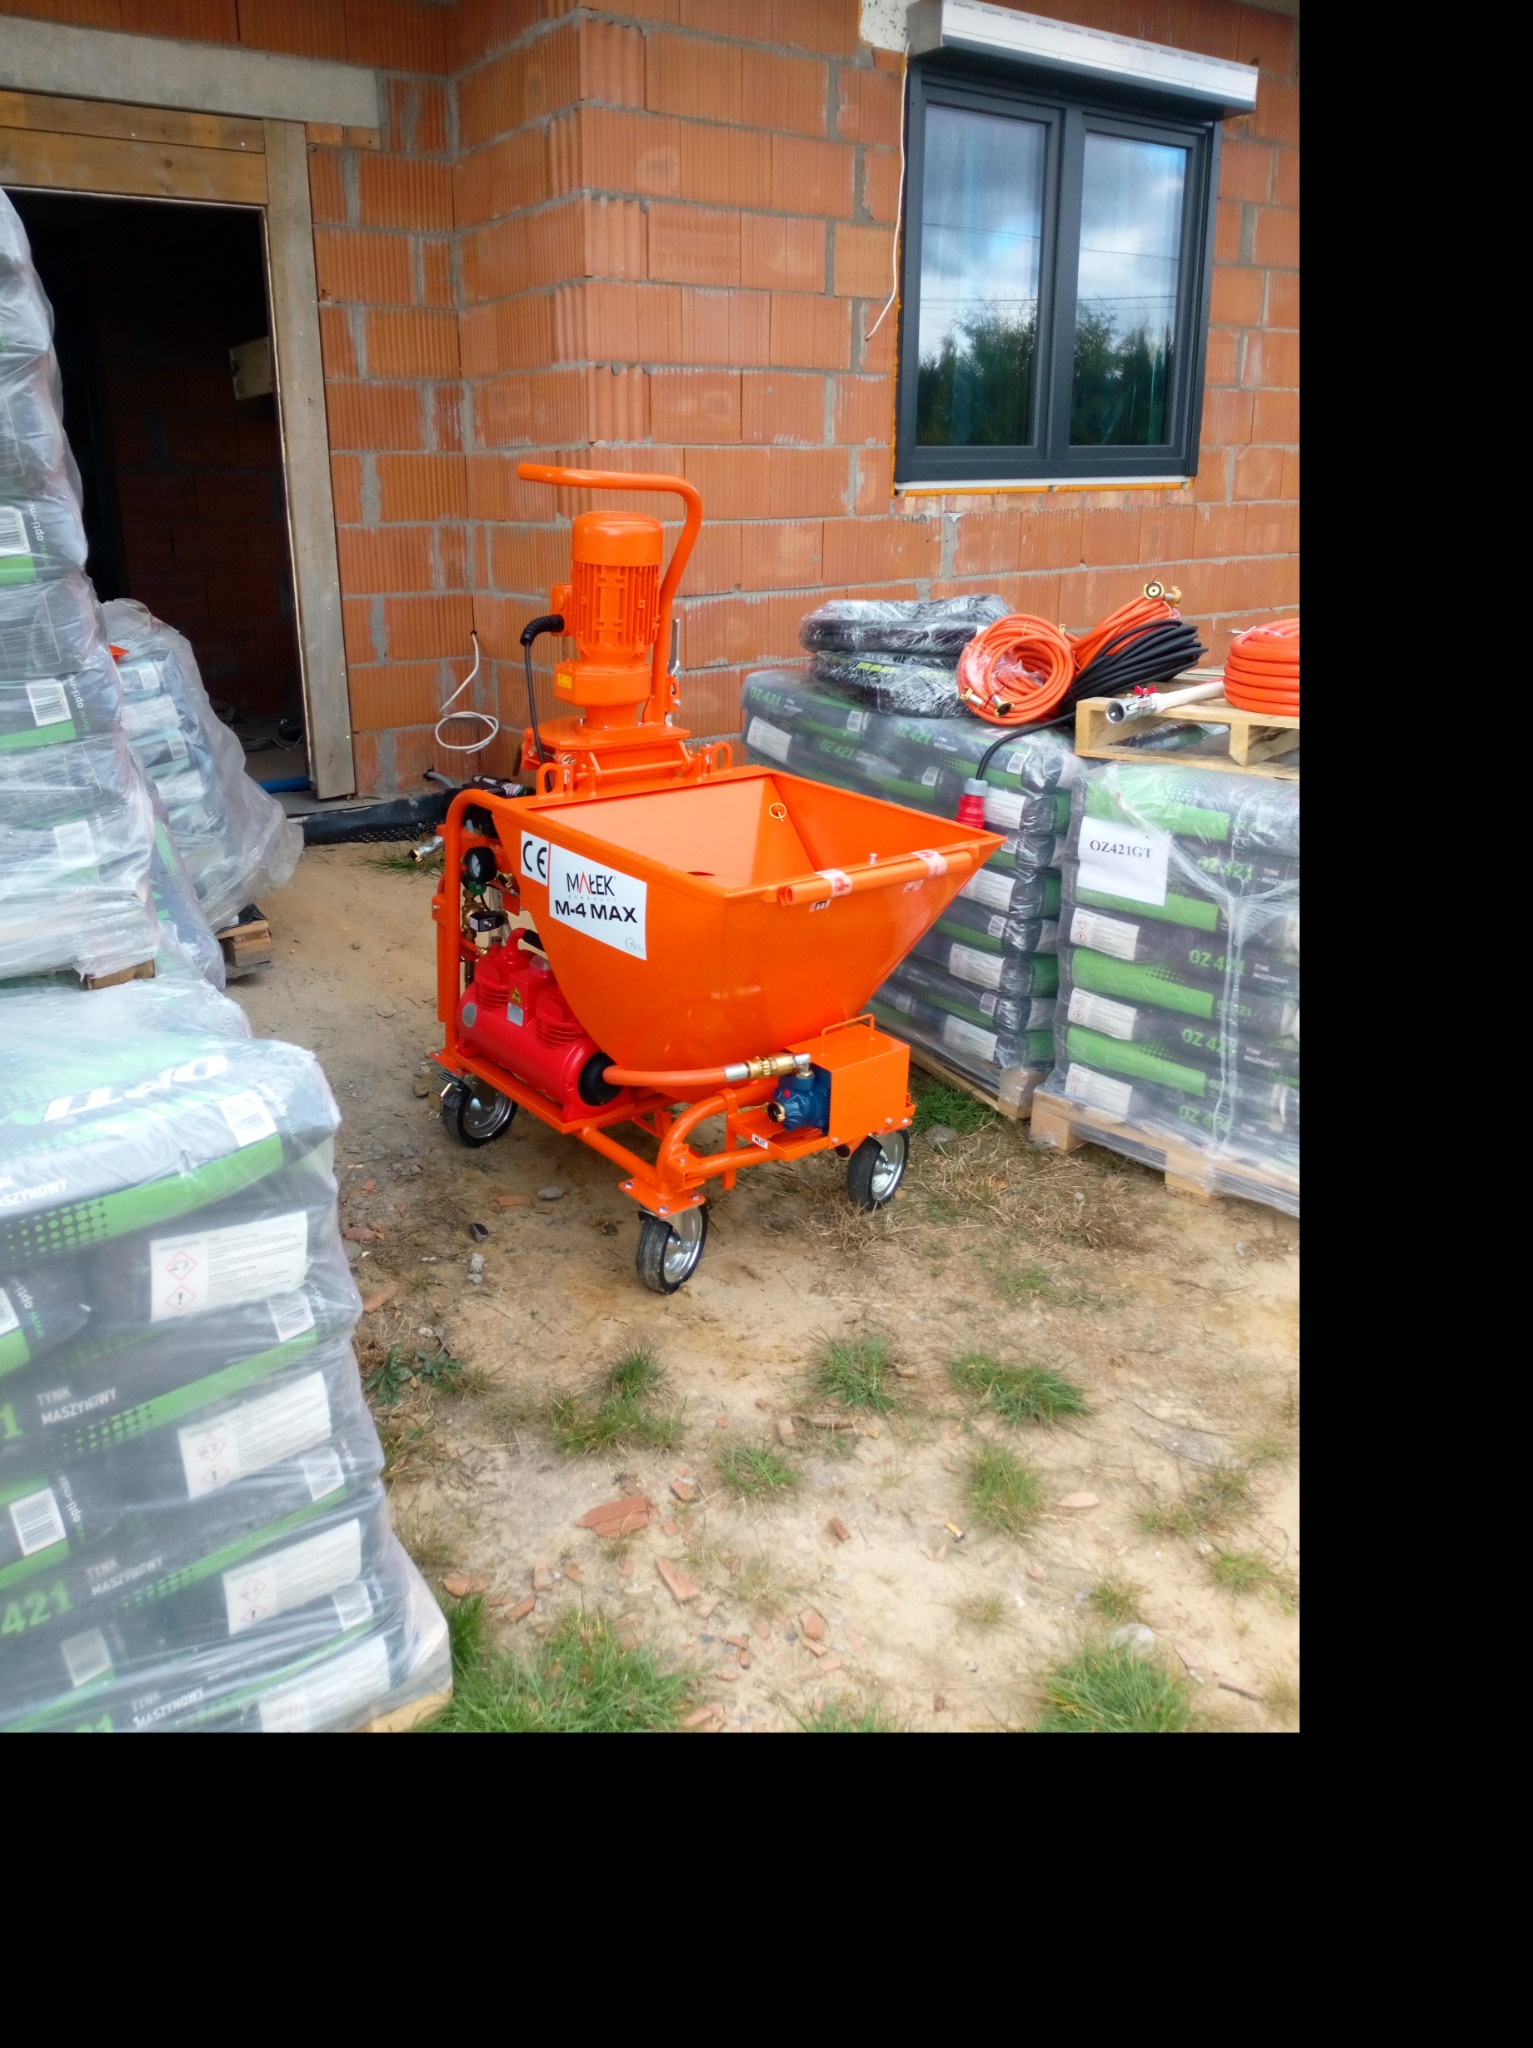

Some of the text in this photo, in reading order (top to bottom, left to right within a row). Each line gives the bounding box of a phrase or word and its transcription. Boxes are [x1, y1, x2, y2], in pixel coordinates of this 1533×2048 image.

[1089, 839, 1154, 859] OZ421GT
[555, 899, 638, 924] M-4 MAX
[1189, 948, 1212, 969] OZ
[1181, 1026, 1204, 1048] OZ
[36, 1385, 72, 1407] TYNK
[41, 1387, 117, 1427] MASZYNOWY
[91, 1556, 163, 1597] MASZYNOWY
[1, 1579, 73, 1636] 421
